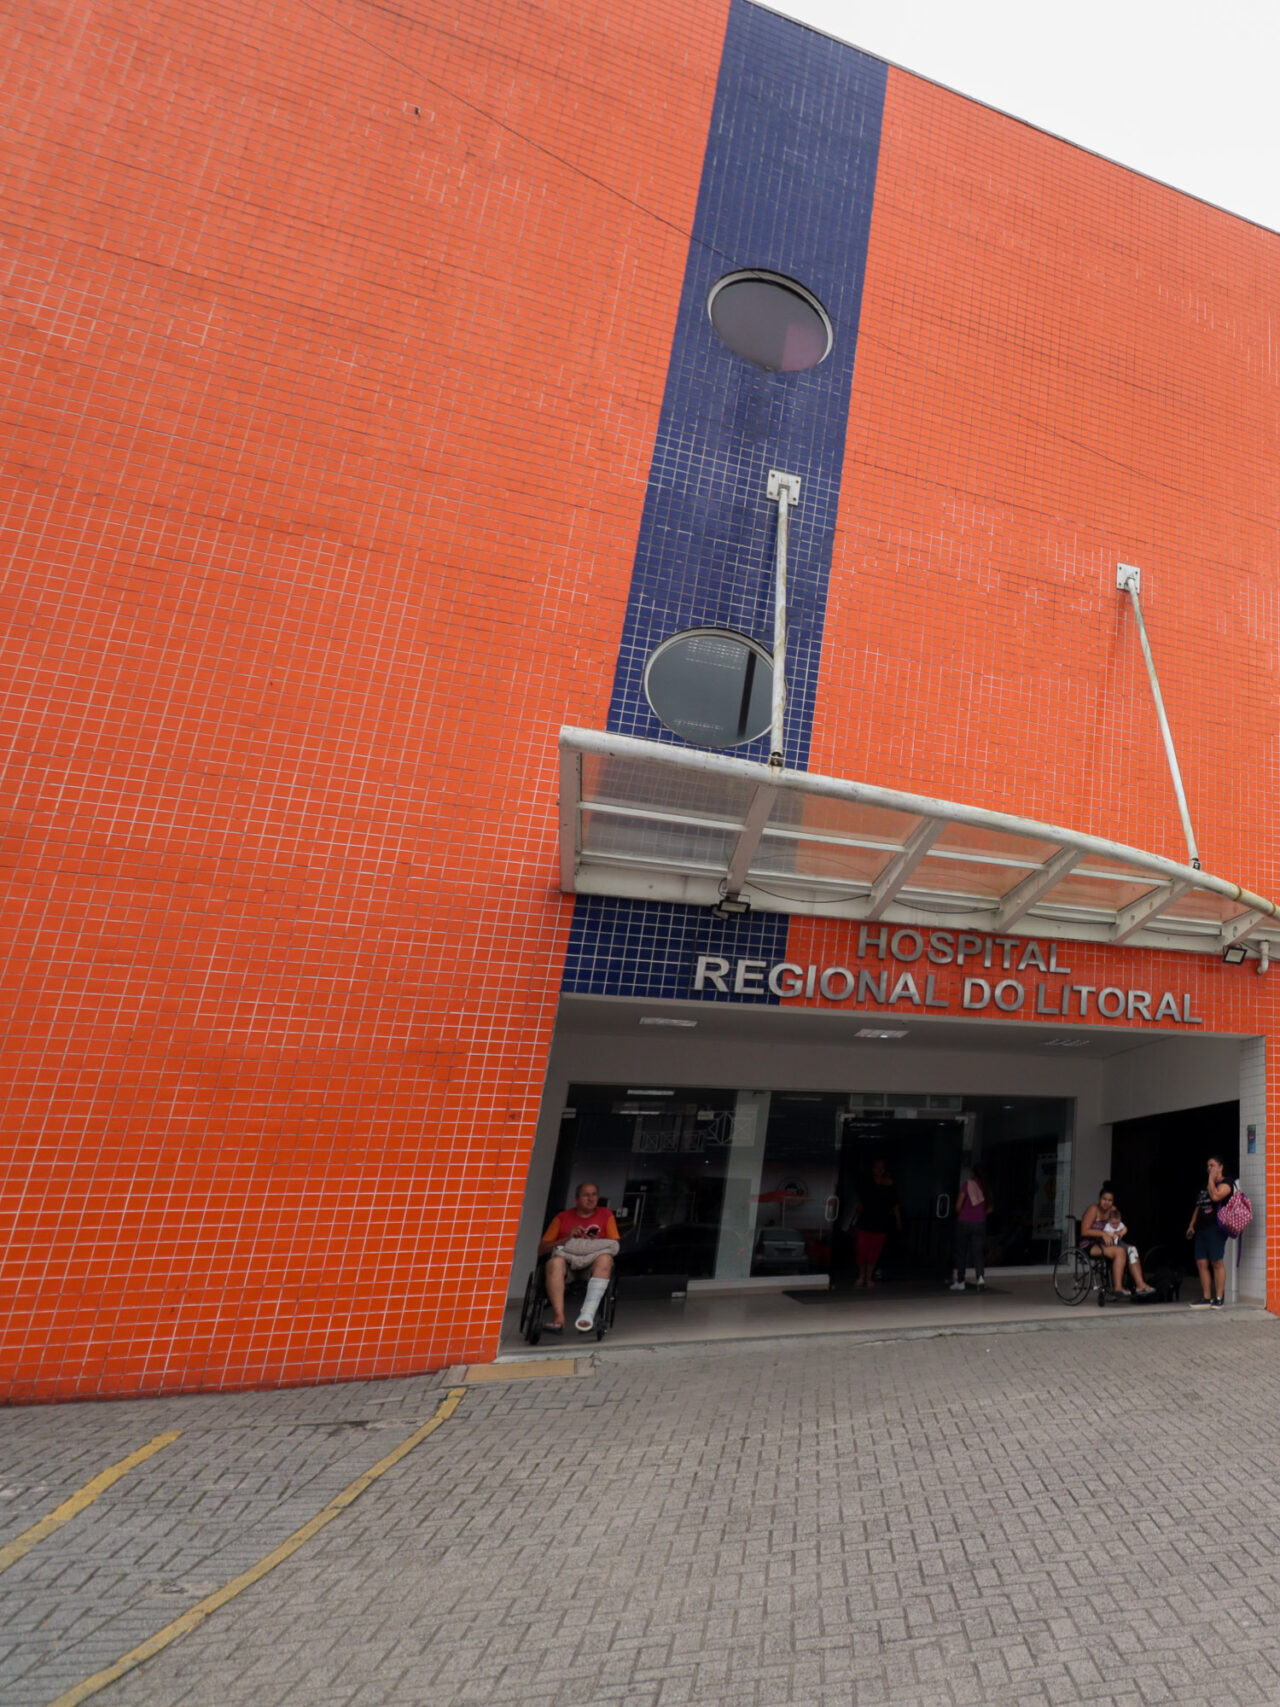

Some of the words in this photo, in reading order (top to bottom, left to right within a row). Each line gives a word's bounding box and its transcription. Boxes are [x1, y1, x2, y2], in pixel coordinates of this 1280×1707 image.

[857, 924, 1072, 975] HOSPITAL
[693, 954, 950, 1008] REGIONAL
[962, 976, 1026, 1012] DO
[1036, 982, 1203, 1024] LITORAL
